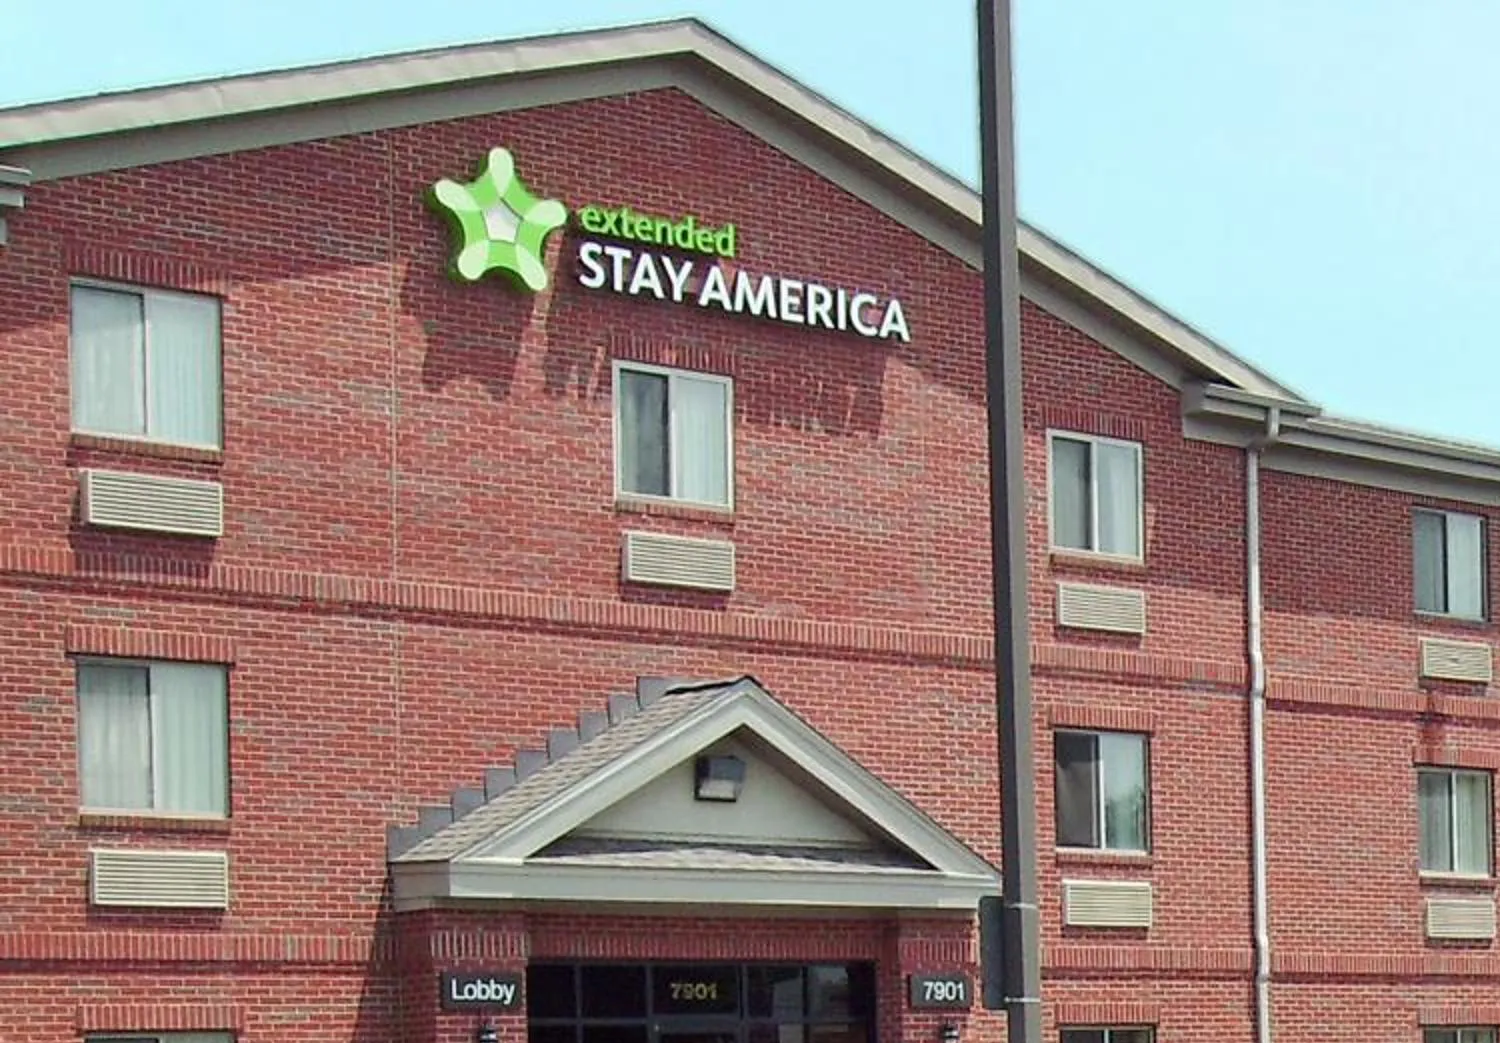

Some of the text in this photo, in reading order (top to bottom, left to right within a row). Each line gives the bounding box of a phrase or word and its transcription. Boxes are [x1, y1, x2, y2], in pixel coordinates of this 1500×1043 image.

[581, 203, 736, 258] extended
[578, 241, 911, 342] STAY AMERICA
[451, 978, 516, 1005] Lobby
[671, 982, 718, 999] 7901
[923, 981, 965, 1001] 7901
